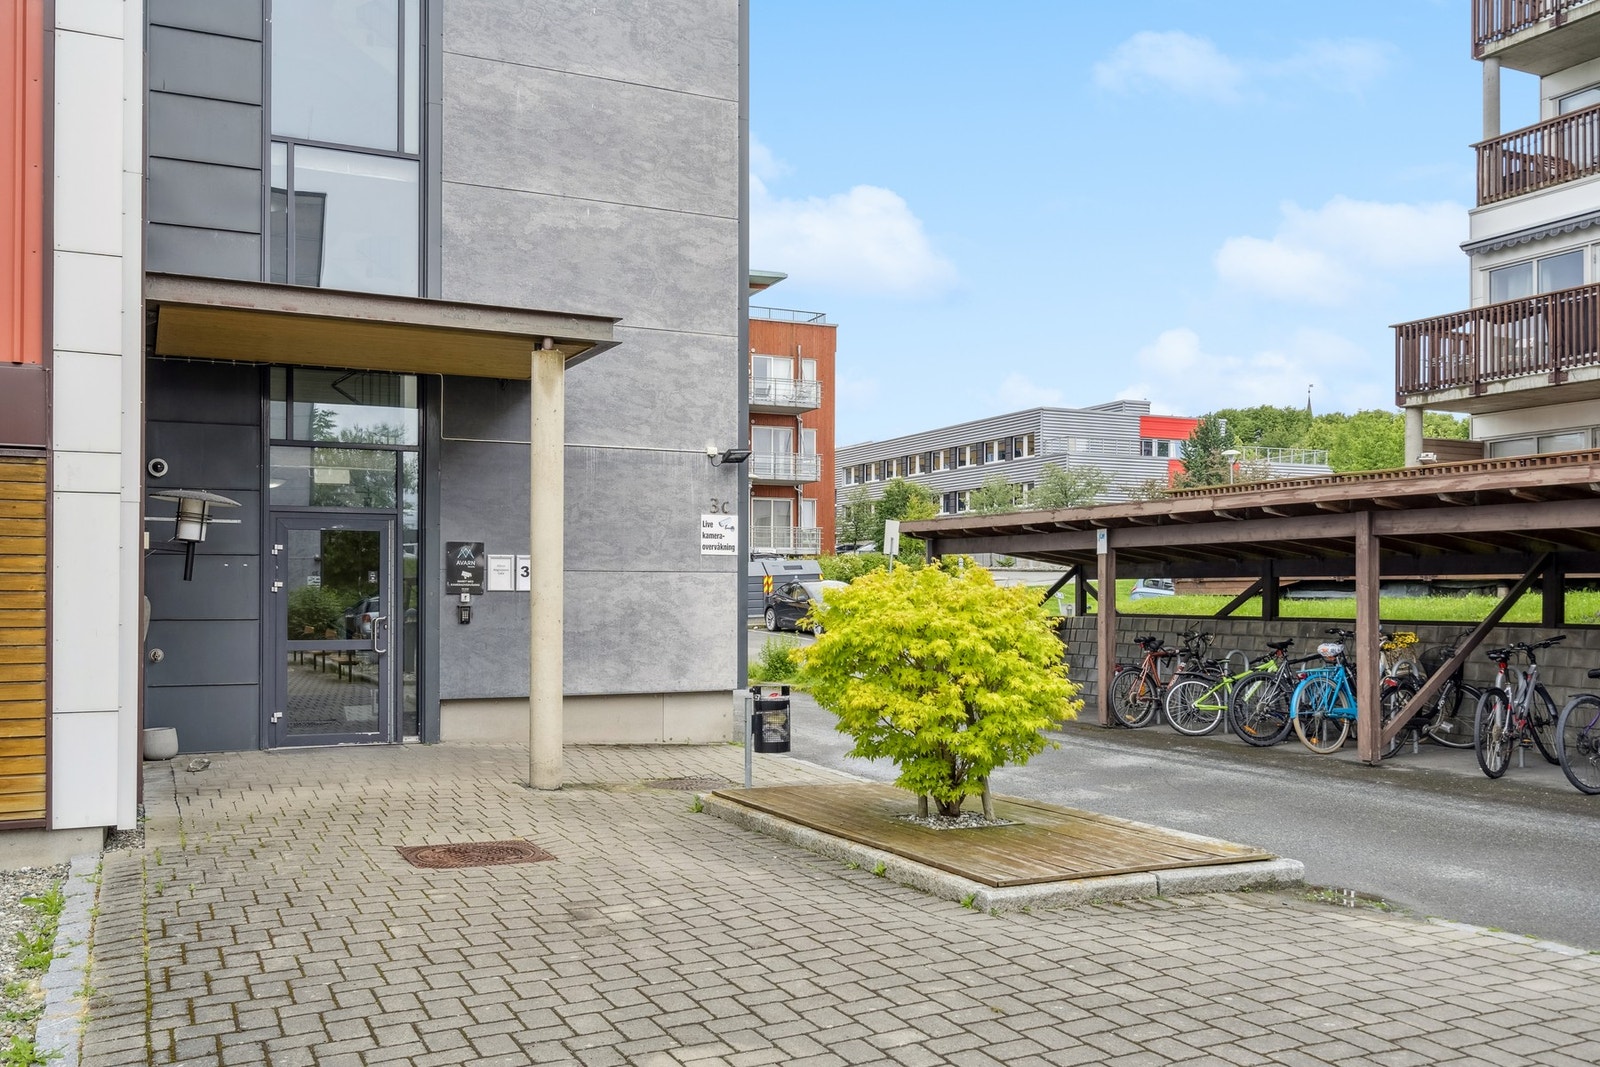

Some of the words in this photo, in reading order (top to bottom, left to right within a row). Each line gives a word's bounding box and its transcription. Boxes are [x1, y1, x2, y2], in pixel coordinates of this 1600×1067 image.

[702, 520, 714, 528] Live
[702, 532, 725, 540] kamera-
[702, 542, 736, 552] overvåkning
[520, 565, 530, 578] 3
